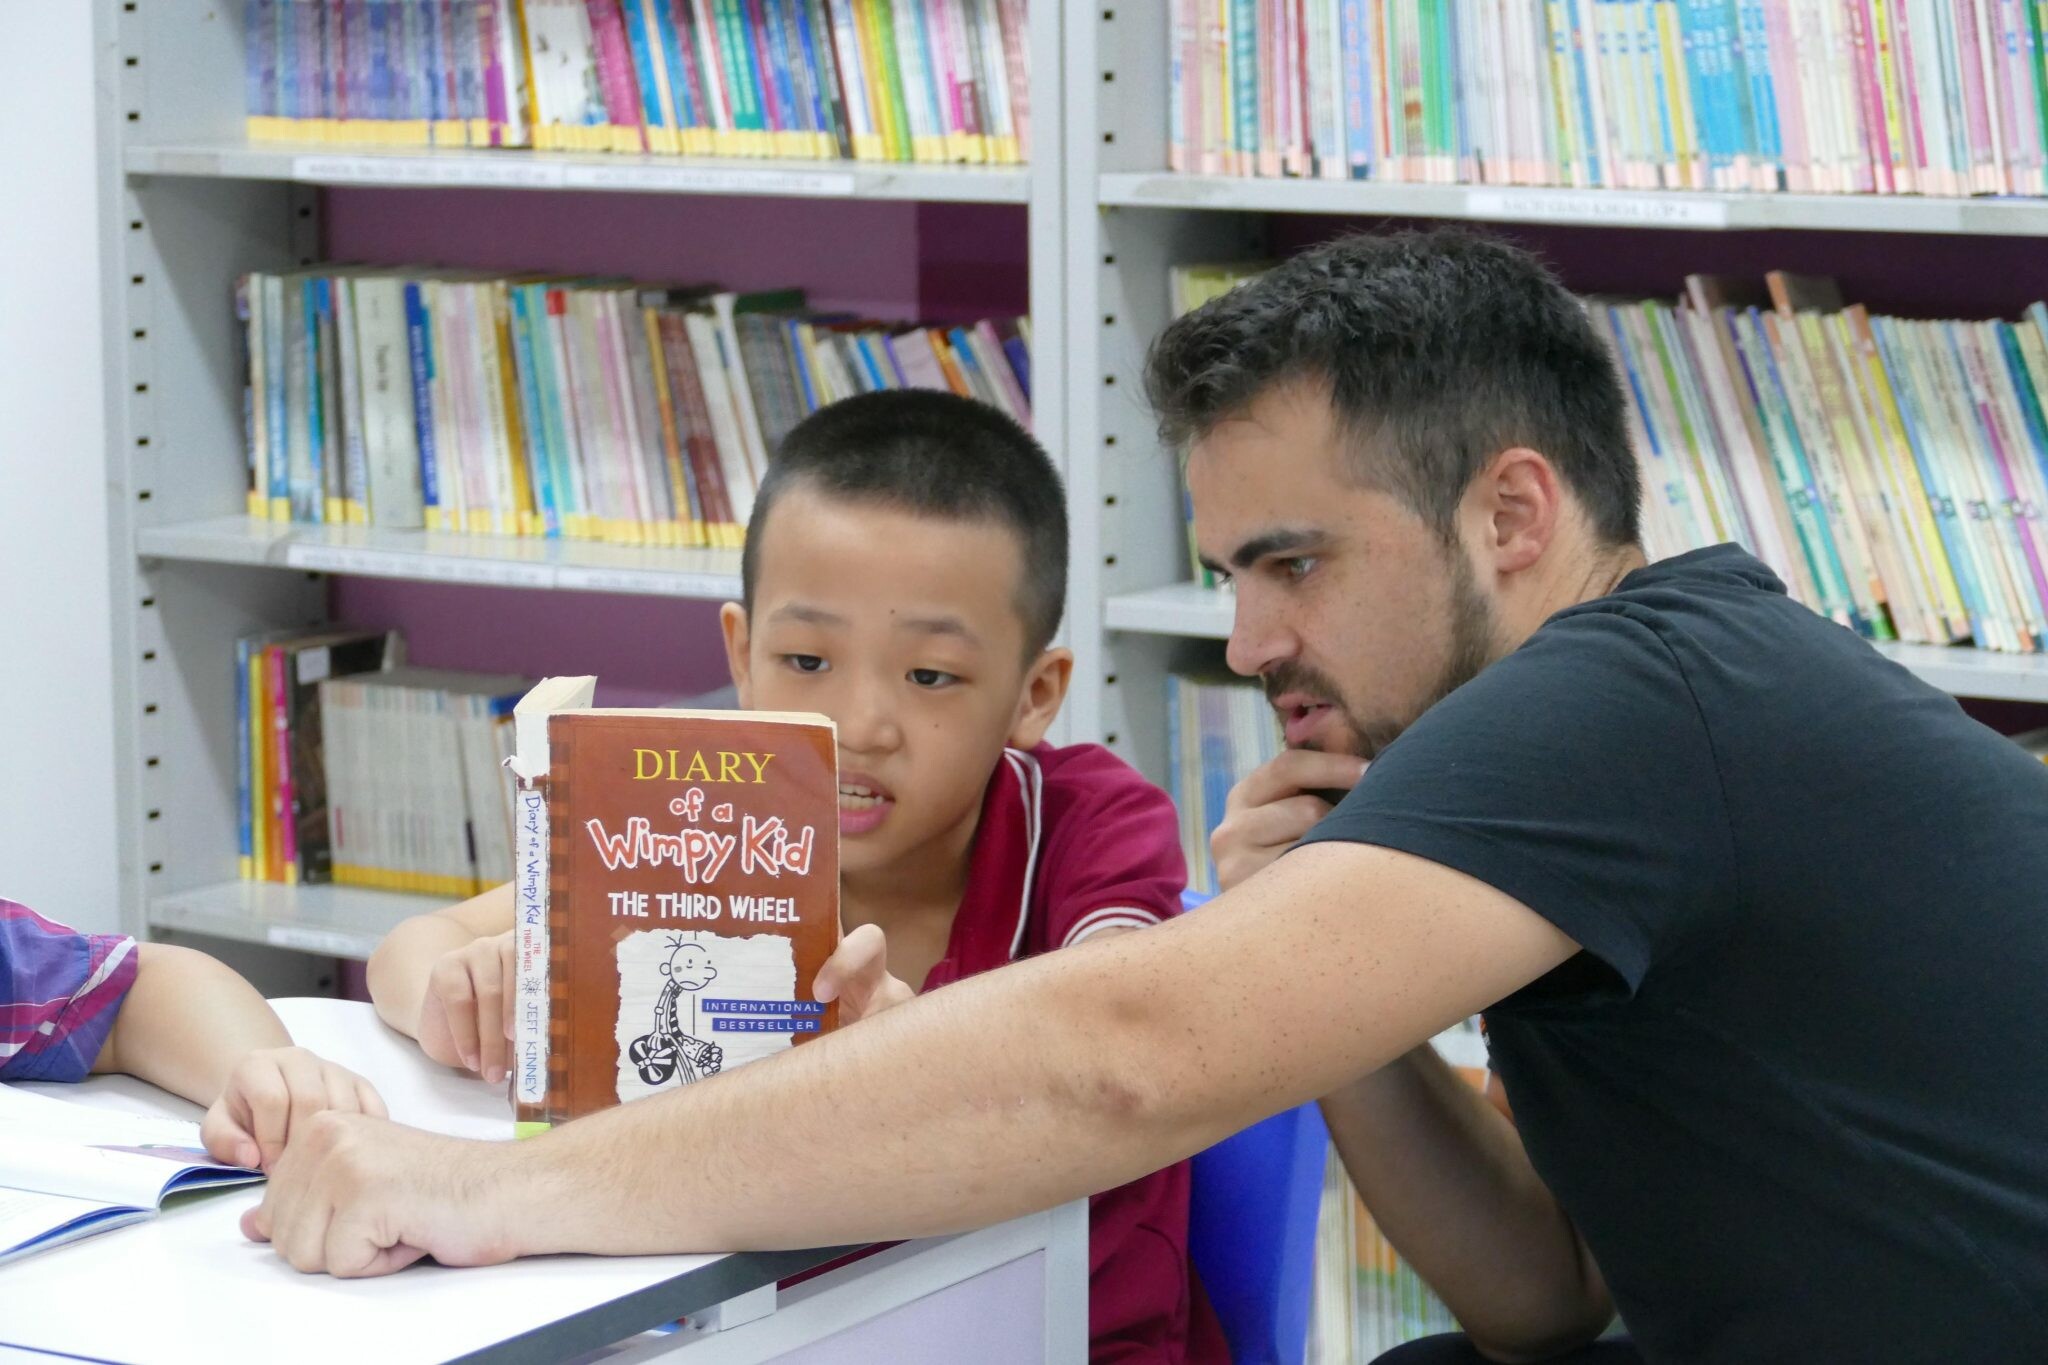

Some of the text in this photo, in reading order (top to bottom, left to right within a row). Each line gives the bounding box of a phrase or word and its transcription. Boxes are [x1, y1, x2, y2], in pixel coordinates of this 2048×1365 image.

[632, 748, 776, 784] DIARY
[525, 795, 541, 834] Diary
[669, 787, 733, 822] of a
[529, 837, 539, 848] of
[586, 815, 814, 883] Wimpy Kid
[523, 859, 539, 905] Wimpy
[526, 904, 541, 925] Kid
[607, 891, 800, 923] THE THIRD WHEEL
[533, 942, 541, 954] THE
[705, 1002, 820, 1012] INTERNATIONAL
[719, 1020, 814, 1030] BESTSELLER
[525, 1001, 538, 1095] JEFF KINNEY
